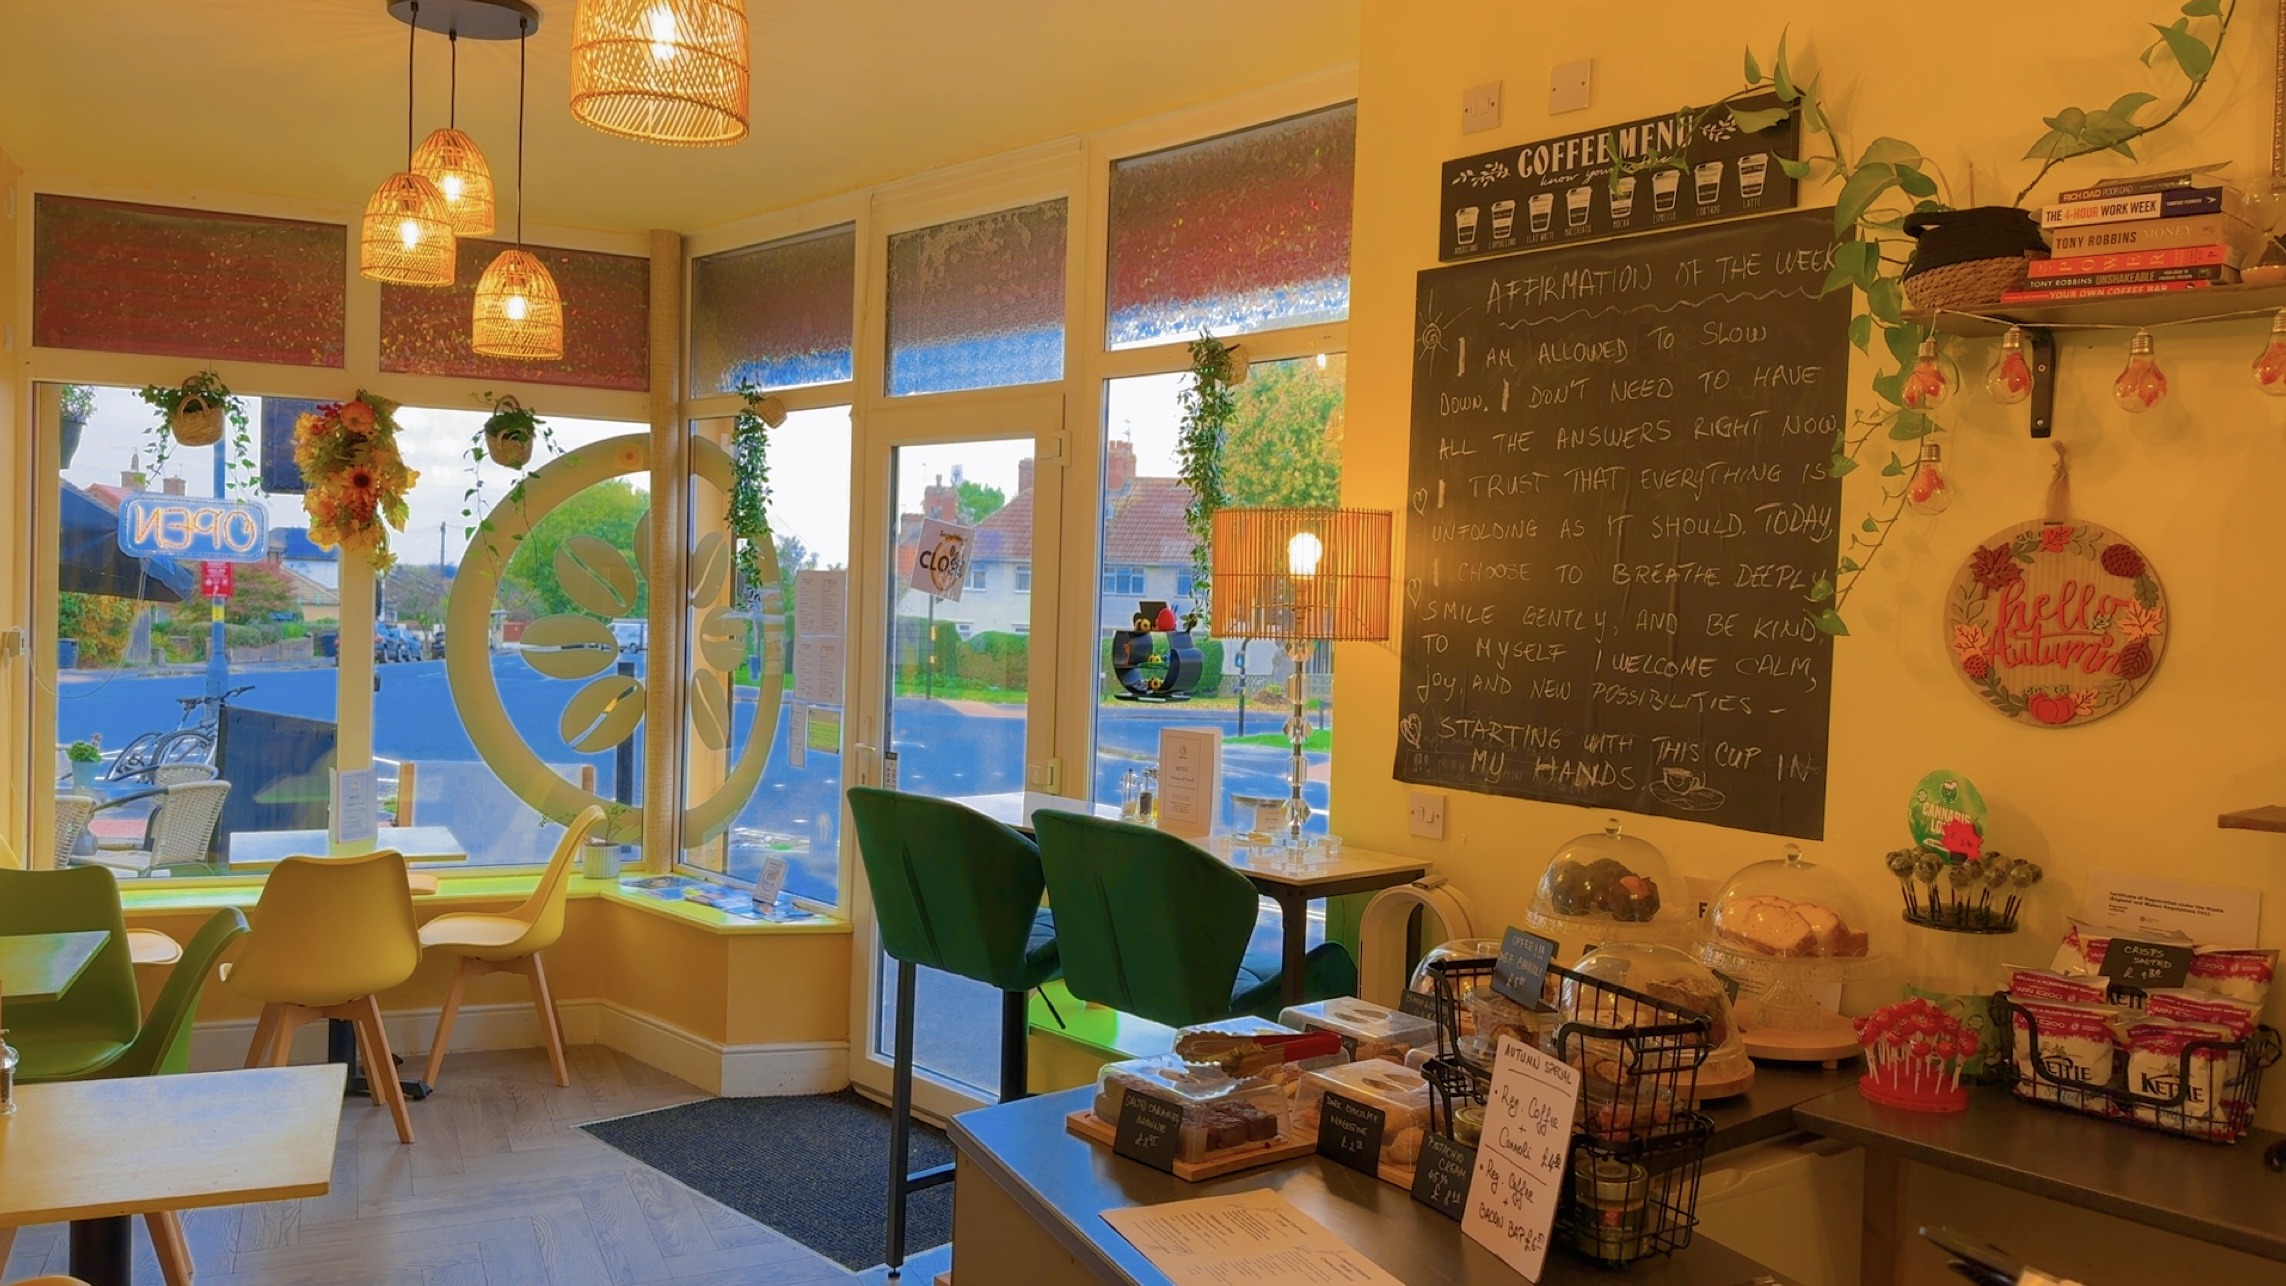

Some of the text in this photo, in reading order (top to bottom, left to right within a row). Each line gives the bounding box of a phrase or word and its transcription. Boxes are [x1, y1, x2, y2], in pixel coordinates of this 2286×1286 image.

[1517, 132, 1609, 179] COFFEE
[1619, 114, 1694, 158] MENU
[1539, 172, 1580, 188] know
[2062, 192, 2082, 202] RICH
[2083, 190, 2101, 200] DAD
[2046, 209, 2062, 222] THE
[2063, 206, 2099, 220] 4-HOUR
[2100, 203, 2129, 218] WORK
[2129, 199, 2157, 214] WEEK
[2056, 224, 2193, 250] TONY ROBBINS MONEY
[1486, 242, 1842, 313] AFFIRMATION OF THE WEEK
[2030, 279, 2053, 288] TONY
[2055, 276, 2093, 287] ROBBINS
[2095, 270, 2156, 286] UNSHAKEABLE
[2049, 290, 2077, 300] YOUR
[2079, 288, 2104, 298] OWN
[1457, 337, 1466, 377] I
[1486, 343, 1512, 367] AM
[1539, 338, 1629, 364] ALLOWED
[1702, 321, 1768, 346] SLOW
[1502, 378, 1510, 412] I
[1529, 377, 1591, 409] DON'T
[1611, 376, 1674, 401] NEED
[1698, 368, 1730, 393] TO
[1753, 366, 1822, 387] HAVE
[1439, 437, 1477, 461] ALL
[1493, 430, 1536, 454] THE
[1556, 419, 1673, 450] ANSWERS
[1694, 410, 1769, 439] RIGHT
[1437, 460, 1828, 508] I TRUST THAT EVERYTHING IS
[1432, 517, 1539, 542] UNFOLDING
[1560, 517, 1586, 539] AS
[1606, 513, 1635, 538] IT
[1457, 562, 1533, 583] CHOOSE
[1555, 564, 1584, 584] TO
[1612, 562, 1721, 588] BREATHE
[1421, 602, 1495, 625] SMILE
[1635, 608, 1679, 636] AND
[1705, 612, 1740, 638] BE
[1983, 579, 2134, 676] hello Autumn
[1422, 633, 1449, 657] TO
[1595, 644, 1601, 672] I
[1612, 653, 1719, 678] WELCOME
[1472, 674, 1512, 697] AND
[1530, 679, 1572, 701] NEW
[1593, 680, 1753, 715] POSSIBILITIES
[1439, 717, 1563, 751] STARTING
[1584, 731, 1634, 753] WITH
[1652, 735, 1701, 764] THIS
[1714, 740, 1763, 771] CUP
[1471, 748, 1505, 784] MY
[1922, 801, 1972, 825] CANNABIS
[2123, 945, 2165, 958] CRISPS
[2132, 956, 2173, 970] SALTED
[2015, 985, 2063, 1000] WIN £200
[2039, 1019, 2065, 1029] £200
[2152, 1005, 2173, 1015] WIN
[1504, 1043, 1572, 1086] AUTUMN SPECIAL
[1528, 1097, 1560, 1137] Coffee
[1499, 1126, 1532, 1161] Cannoli
[1438, 1157, 1467, 1180] CREAM
[1508, 1174, 1535, 1211] Coffee
[1479, 1202, 1505, 1230] BACON
